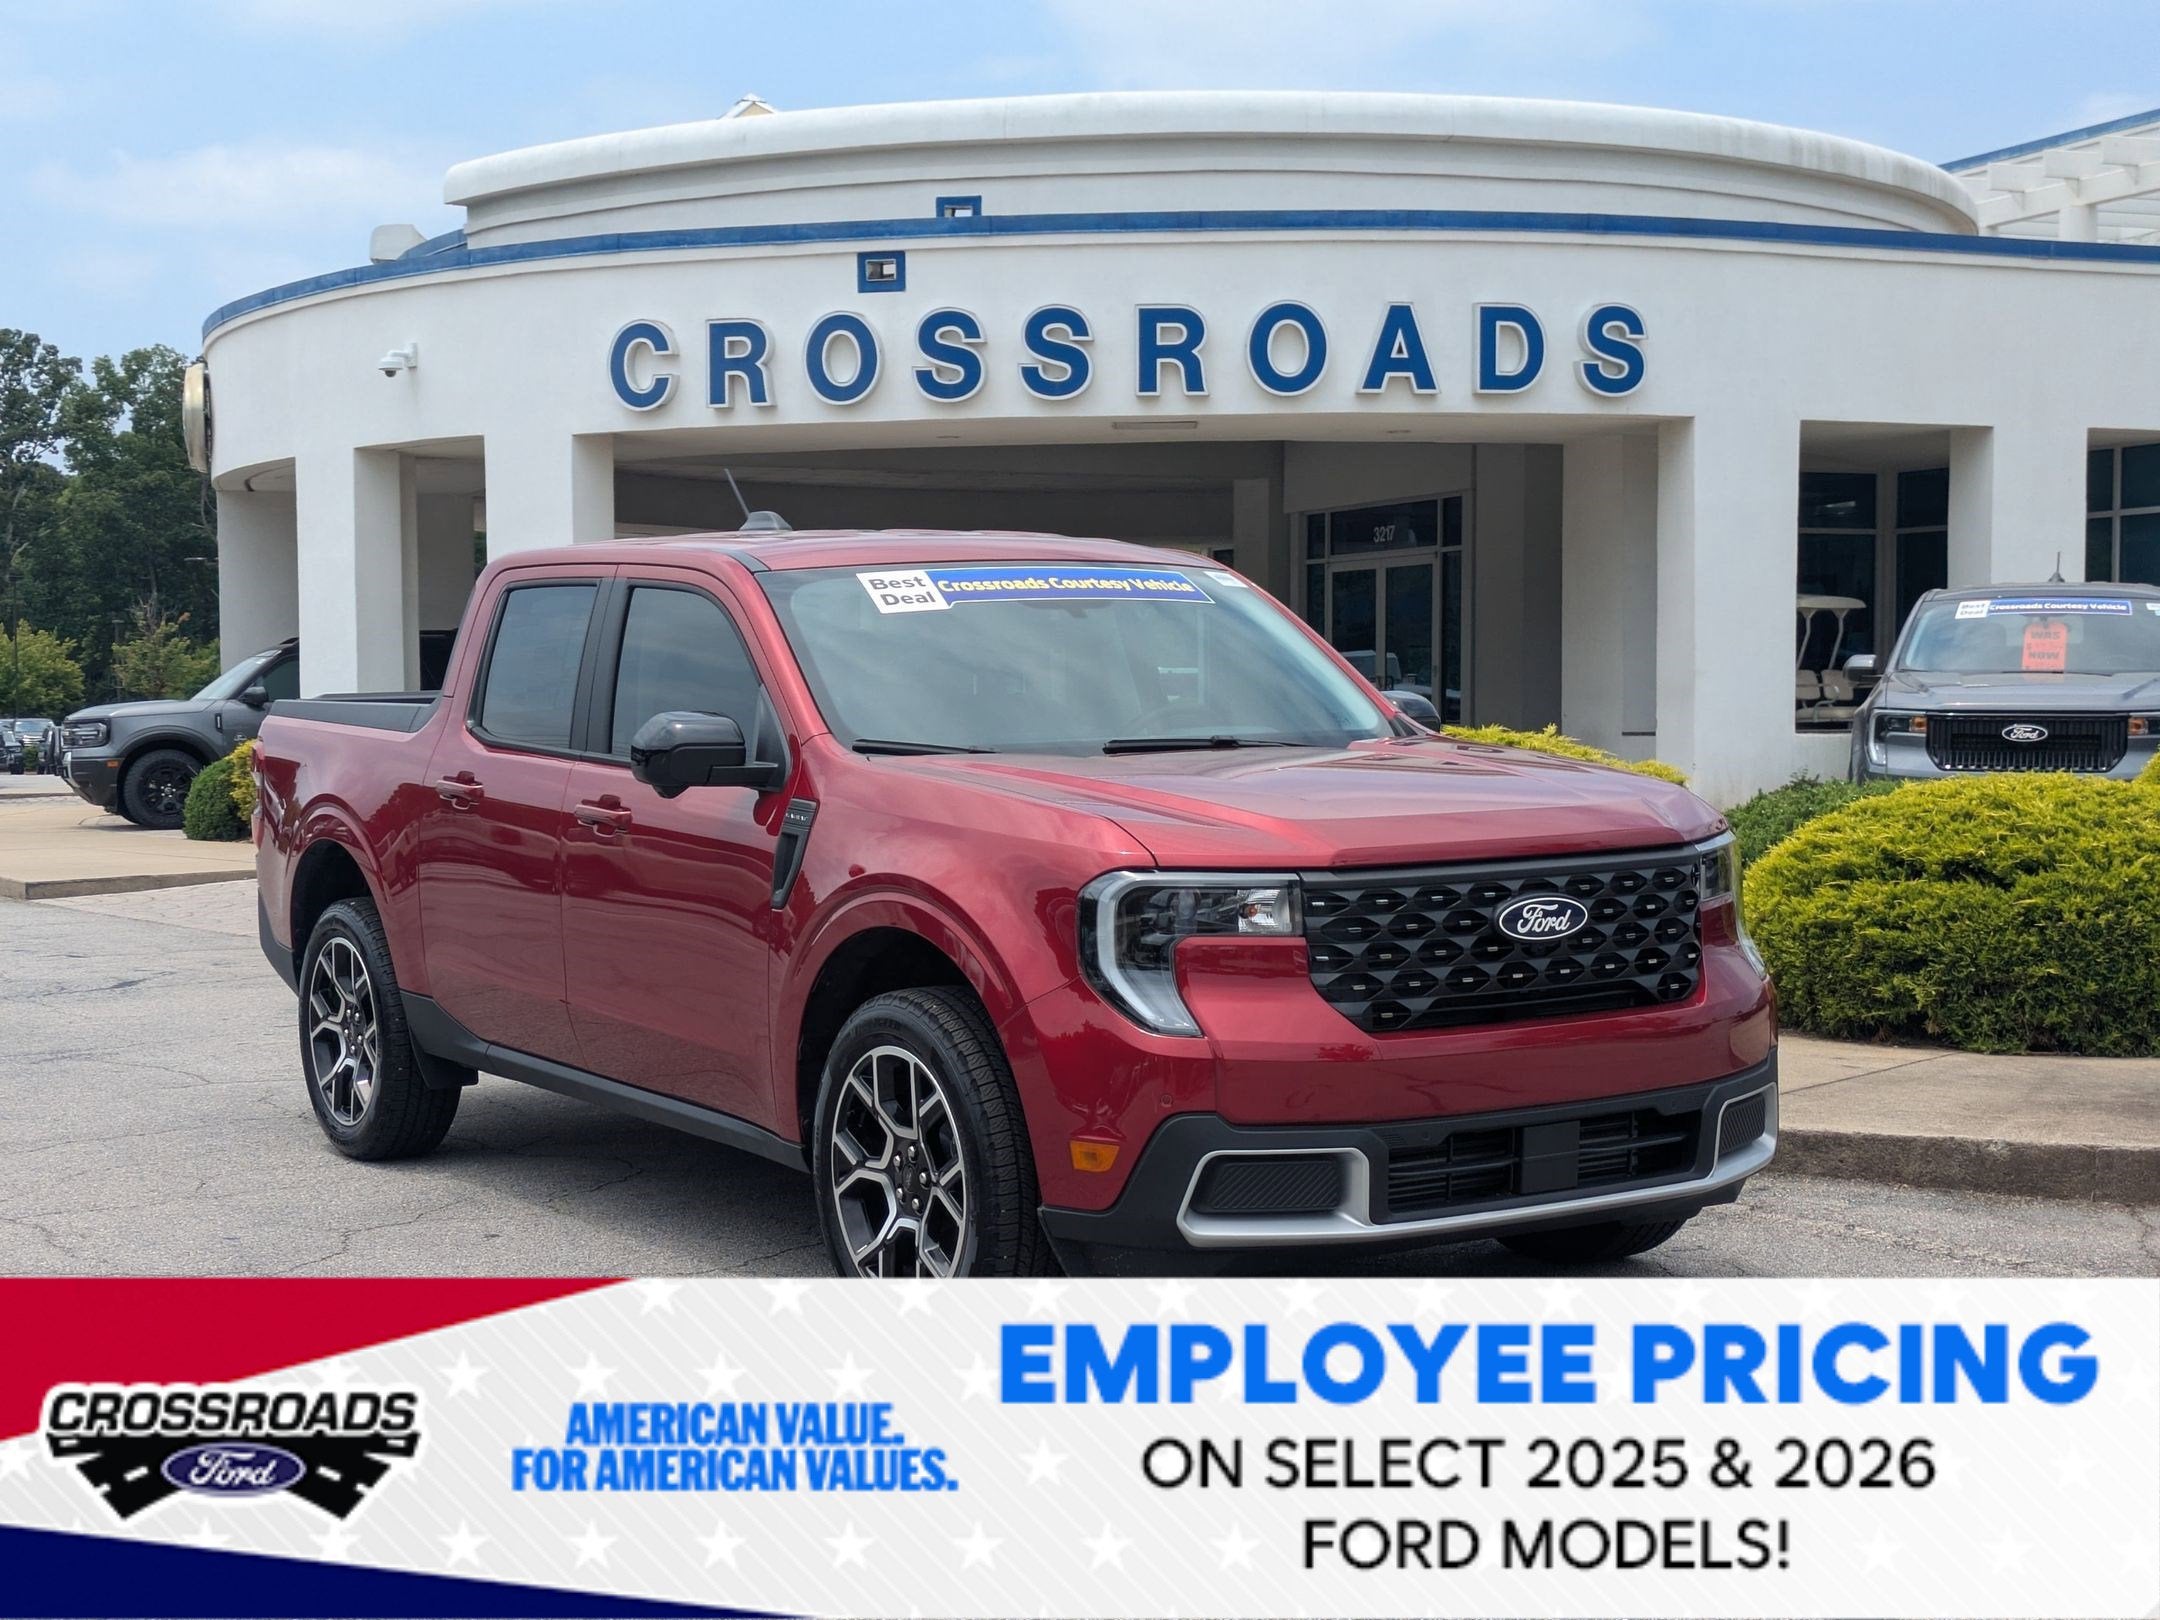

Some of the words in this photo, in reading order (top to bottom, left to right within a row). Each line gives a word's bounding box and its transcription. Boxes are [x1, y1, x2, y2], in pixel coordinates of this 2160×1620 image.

[610, 300, 1649, 412] CROSSROADS
[1373, 525, 1396, 543] 3217
[868, 576, 927, 590] Best
[937, 577, 1050, 592] Crossroads
[1049, 577, 1132, 592] Courtesy
[1128, 578, 1196, 593] Vehicle
[880, 591, 937, 606] Deal
[1989, 602, 2043, 611] Crossroads
[2044, 602, 2087, 612] Courtesy
[2088, 603, 2128, 612] Vehicle
[2009, 724, 2041, 740] Ford
[1516, 903, 1572, 934] Ford
